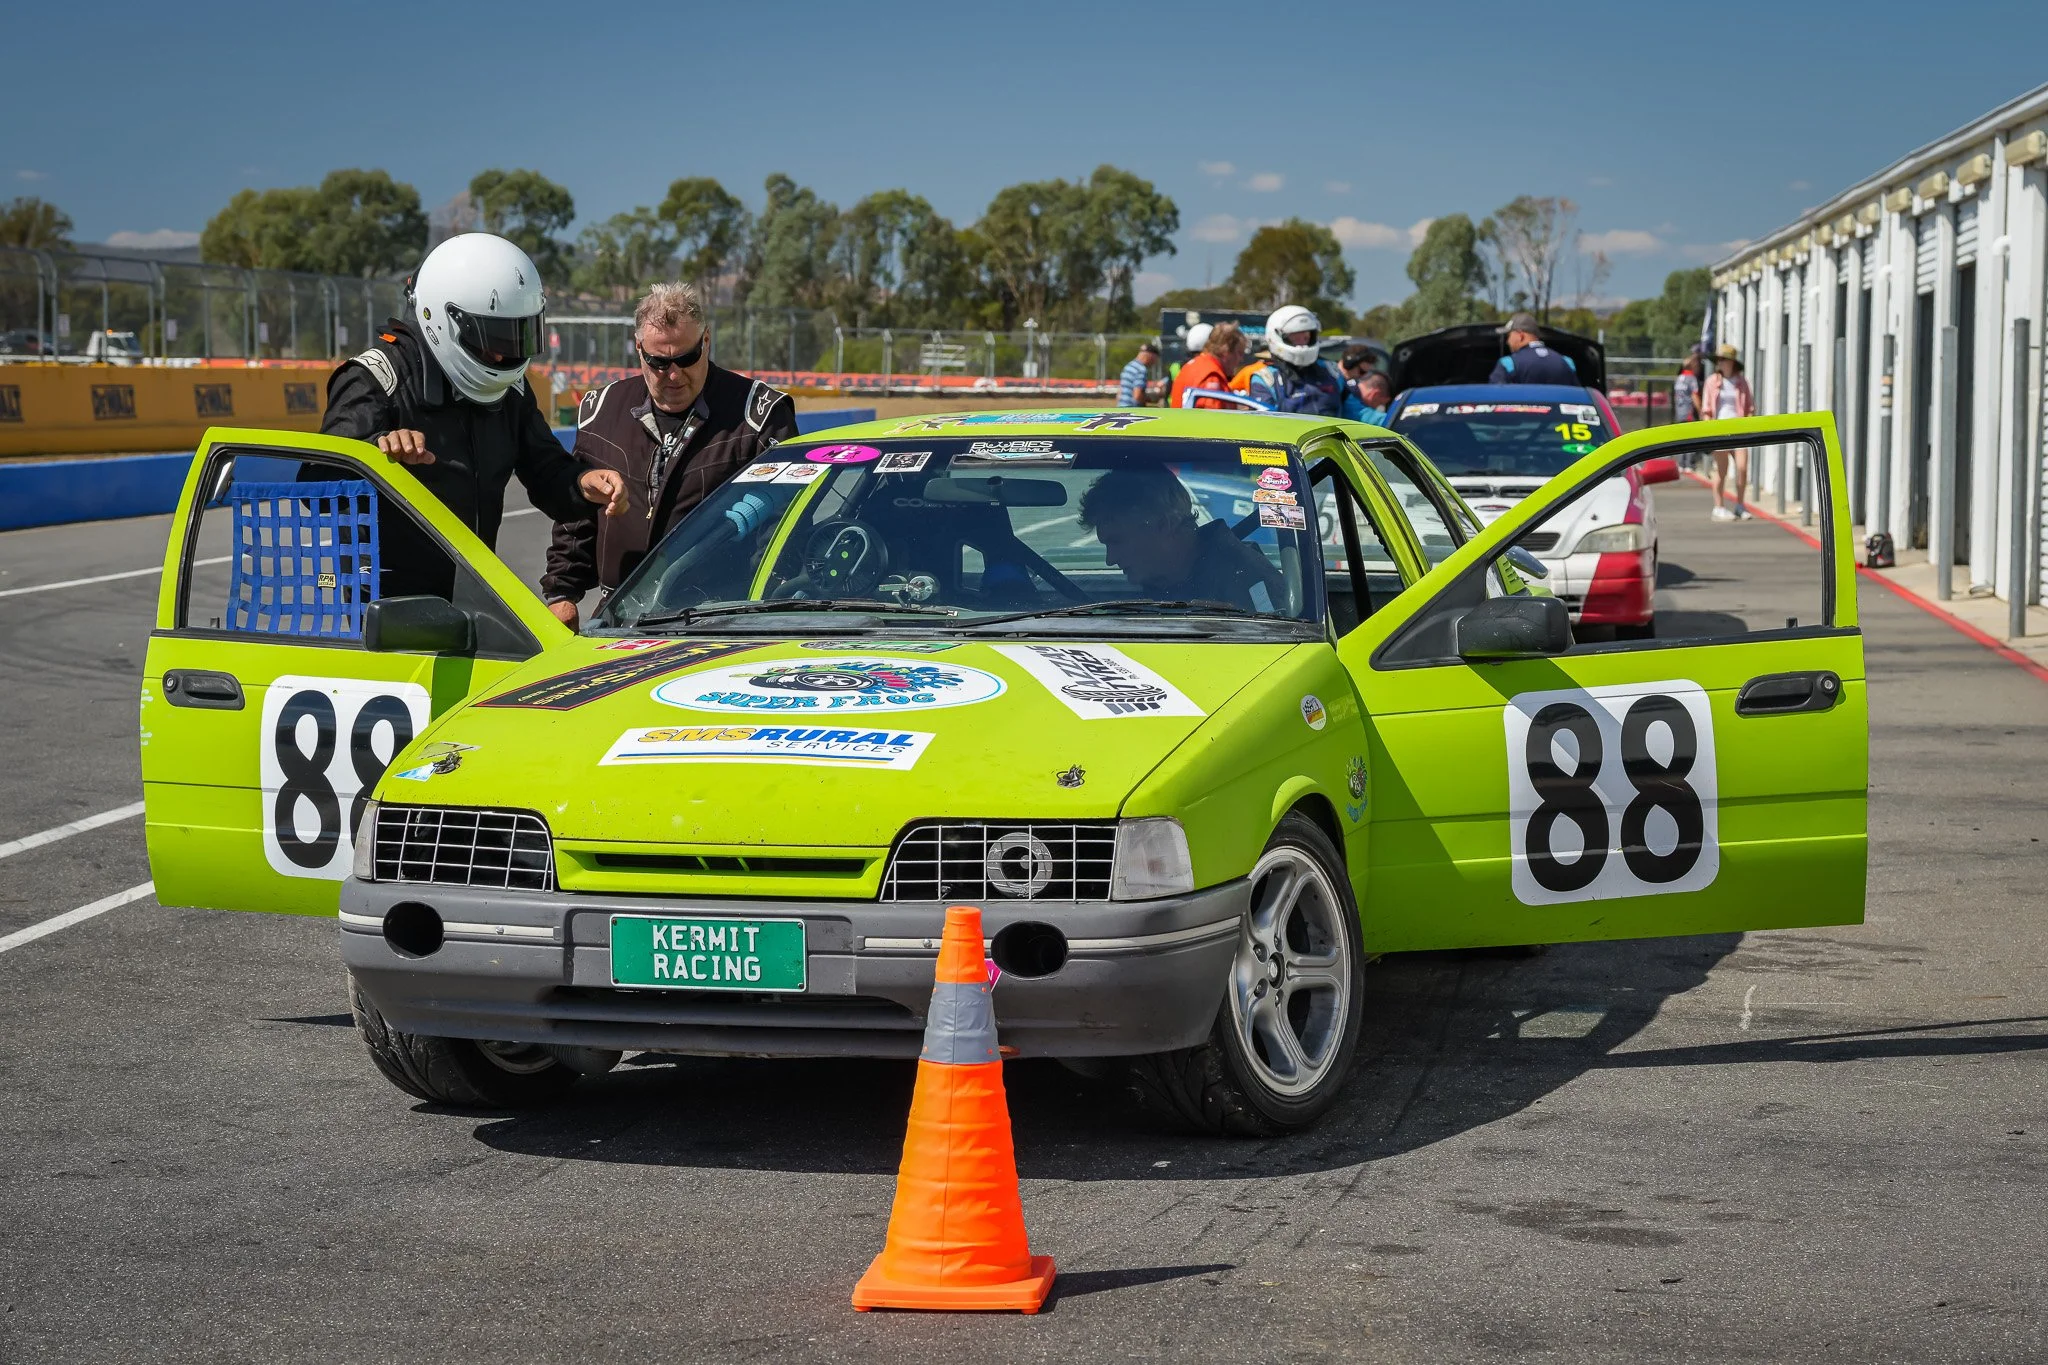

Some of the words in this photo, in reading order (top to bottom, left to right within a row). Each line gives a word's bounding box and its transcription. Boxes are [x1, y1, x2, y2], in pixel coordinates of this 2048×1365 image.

[1555, 423, 1592, 441] 15
[319, 574, 335, 582] RPM
[1060, 648, 1139, 690] TYRES
[697, 691, 820, 709] SUPER
[827, 692, 936, 709] FROG
[766, 741, 907, 754] SERVICES
[275, 689, 413, 869] 88
[1525, 695, 1704, 892] 88
[652, 925, 760, 953] KERMIT
[654, 953, 761, 982] RACING
